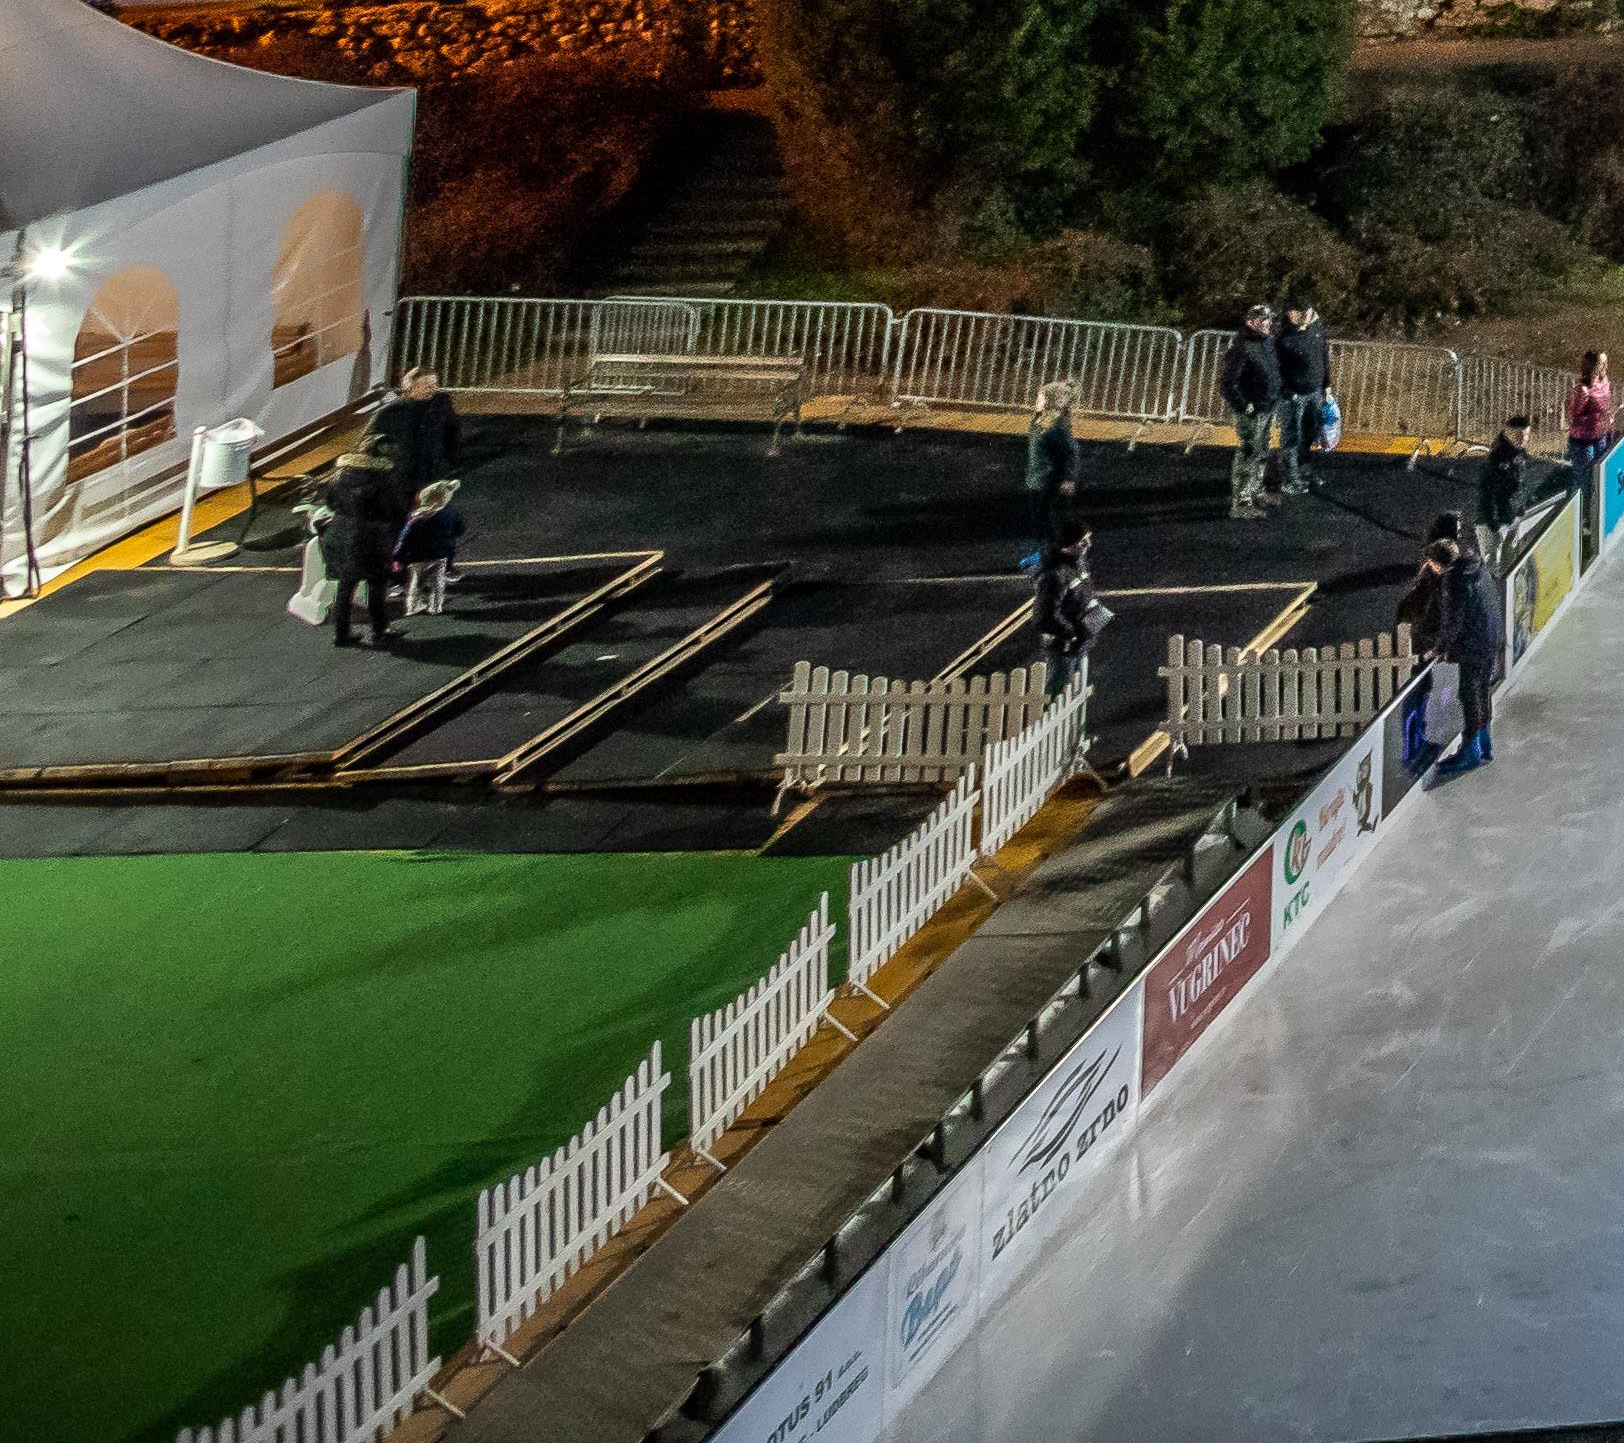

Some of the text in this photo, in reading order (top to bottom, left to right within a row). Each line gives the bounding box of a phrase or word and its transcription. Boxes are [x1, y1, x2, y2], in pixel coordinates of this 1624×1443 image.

[1283, 880, 1311, 930] KTC
[1168, 911, 1251, 1023] VUGRINEC
[991, 1082, 1129, 1262] zlatno zrno
[815, 1368, 833, 1404] 91
